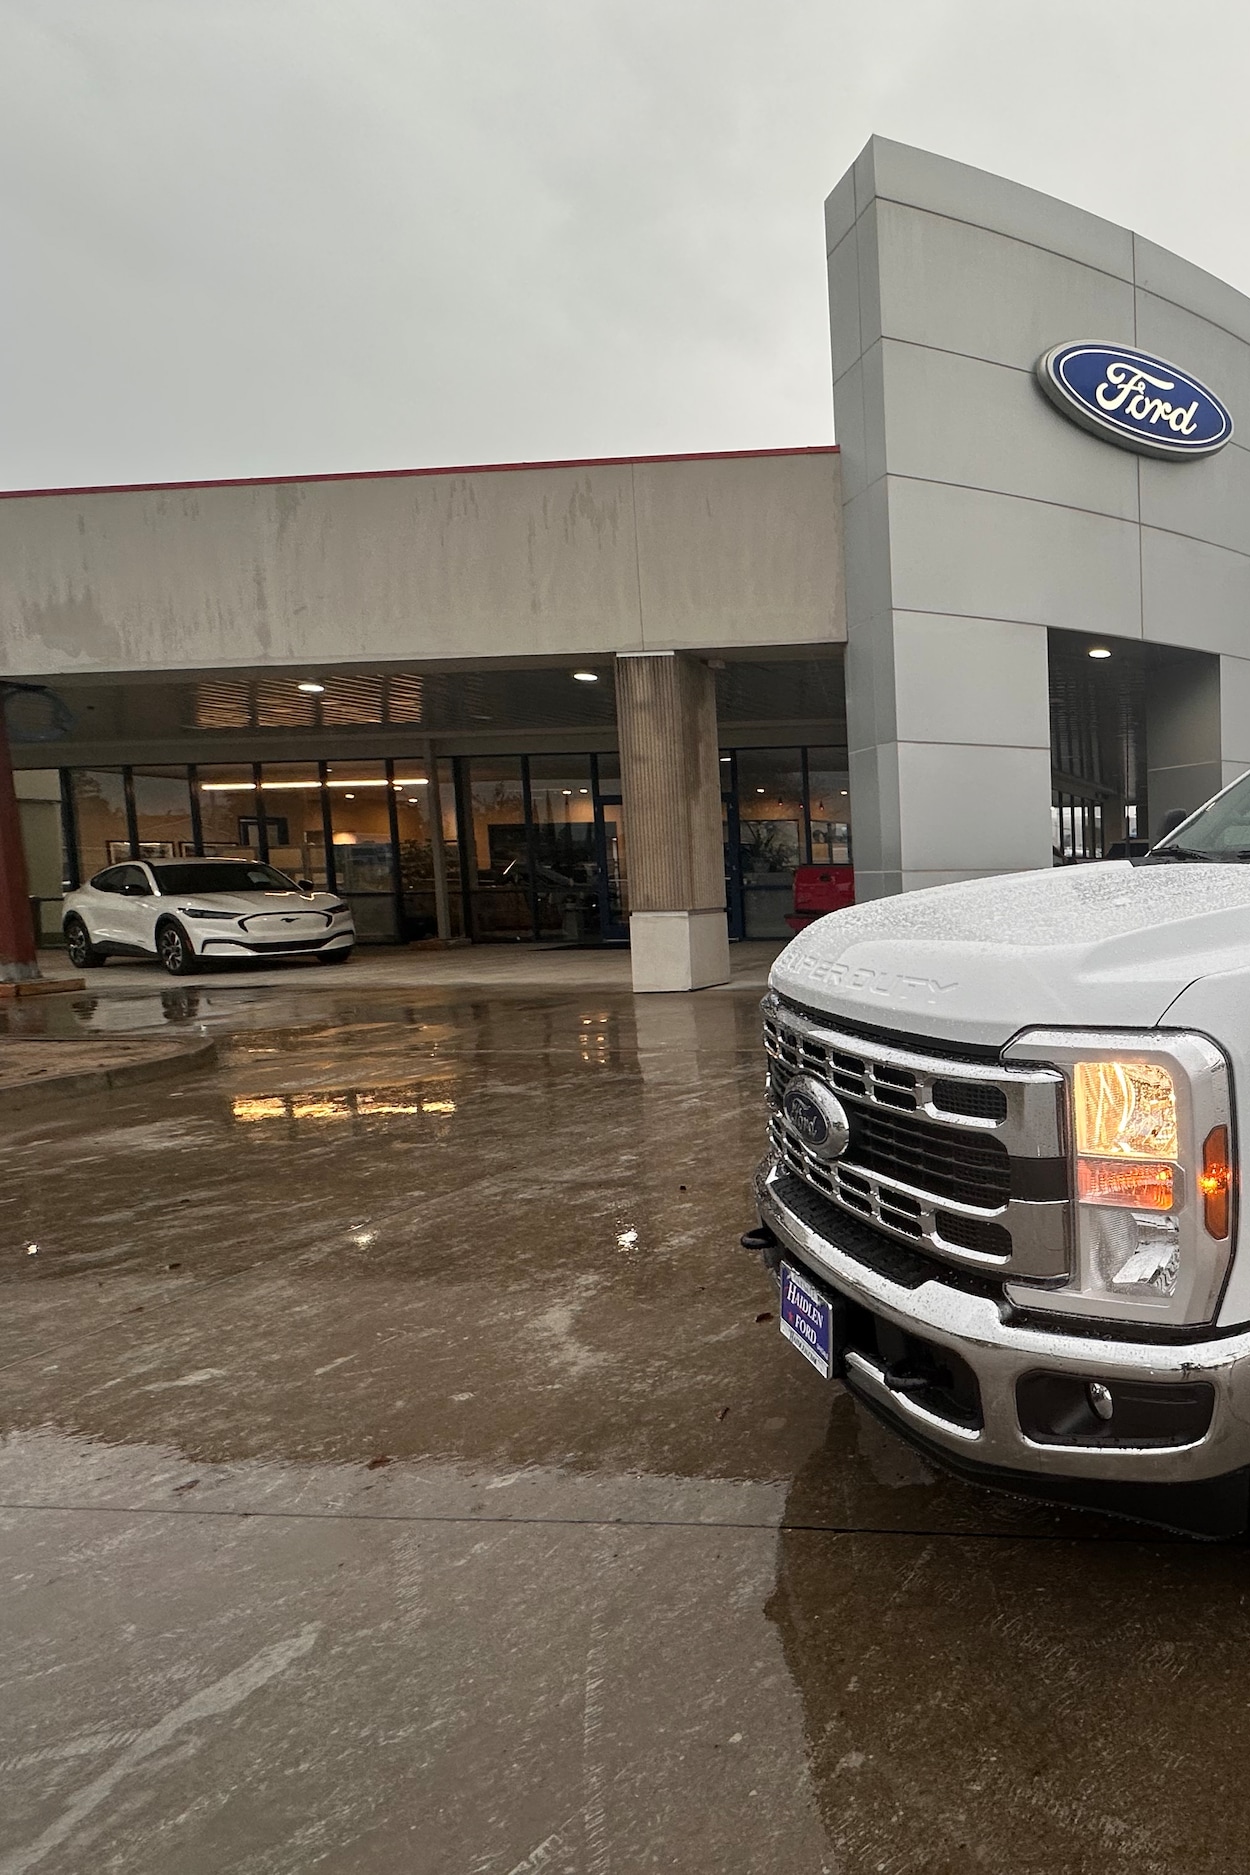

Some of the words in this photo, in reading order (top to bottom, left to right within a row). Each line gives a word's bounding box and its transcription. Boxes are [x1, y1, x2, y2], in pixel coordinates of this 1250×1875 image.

[1095, 361, 1199, 436] Ford
[790, 1097, 817, 1138] Ford
[787, 1281, 823, 1329] HAIDLEN
[795, 1313, 817, 1345] FORD
